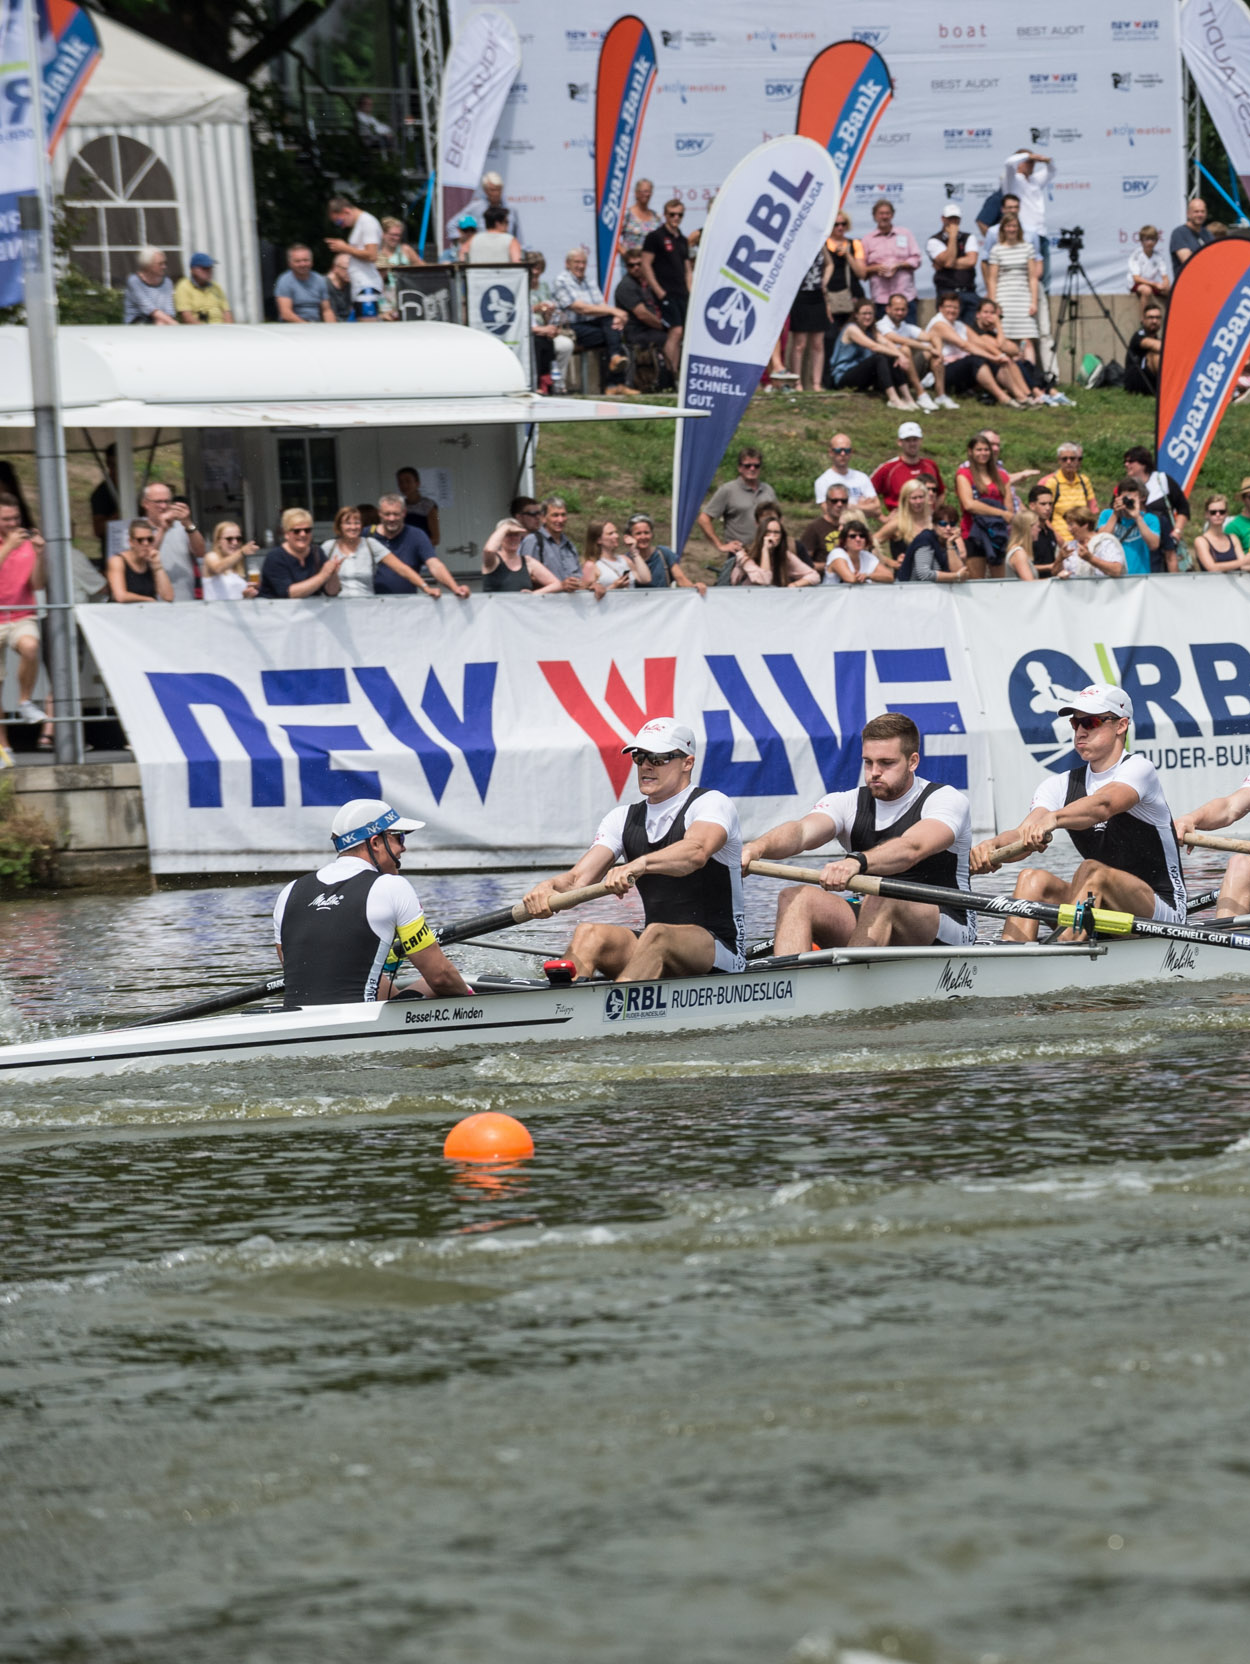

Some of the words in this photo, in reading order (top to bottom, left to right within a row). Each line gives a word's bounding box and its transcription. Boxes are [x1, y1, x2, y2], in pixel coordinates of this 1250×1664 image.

[938, 24, 987, 38] boat
[1016, 26, 1048, 37] BEST
[1050, 25, 1086, 36] AUDIT
[764, 84, 795, 96] DRV
[930, 79, 962, 90] BEST
[964, 78, 1000, 89] AUDIT
[834, 79, 884, 172] a-Bank
[601, 54, 652, 232] Sparda-Bank
[675, 139, 705, 151] DRV
[876, 133, 912, 144] AUDIT
[1122, 180, 1151, 193] DRV
[725, 170, 815, 286] RBL
[762, 180, 825, 295] RUDER-BUNDESLIGA
[690, 362, 732, 380] STARK.
[688, 378, 747, 397] SCHNELL.
[687, 393, 715, 408] GUT.
[145, 661, 498, 808] NEW
[538, 646, 970, 803] WAVE
[341, 832, 357, 846] NK
[366, 821, 382, 835] NK
[384, 811, 399, 824] NK
[402, 922, 432, 953] CAPT
[1136, 922, 1167, 936] STARK.
[1167, 927, 1208, 942] SCHNELL.
[1208, 933, 1229, 945] GUT.
[626, 985, 668, 1012] RBL
[671, 979, 793, 1009] RUDER-BUNDESLIGA
[405, 1009, 450, 1024] Bessel-R.C.
[452, 1007, 484, 1021] Minden
[625, 1010, 667, 1019] RUDER-BUNDESLIGA
